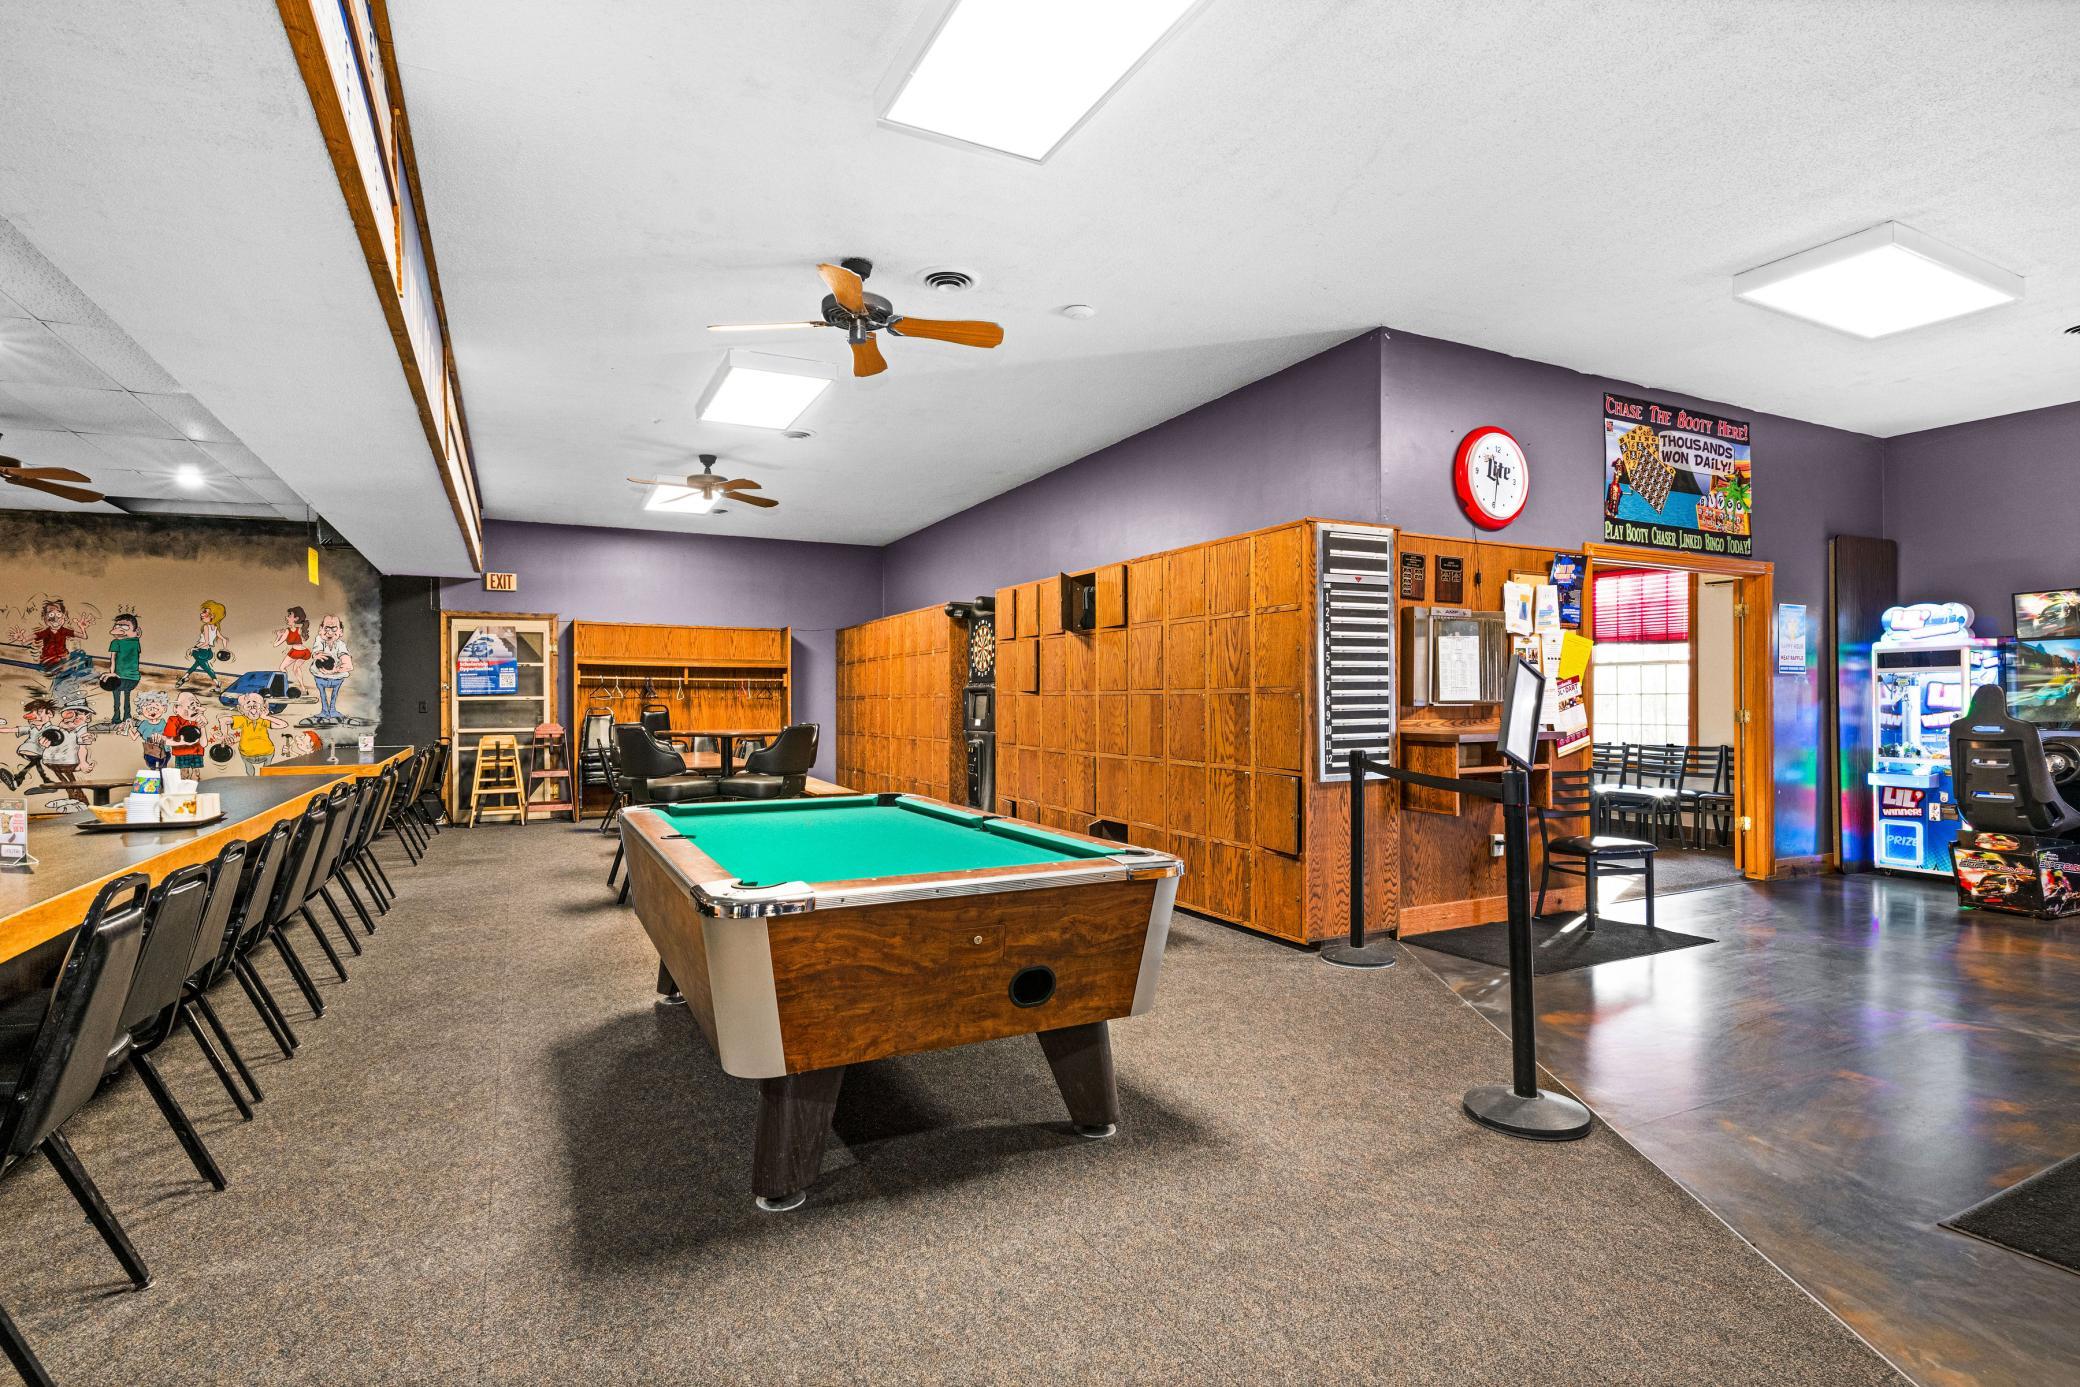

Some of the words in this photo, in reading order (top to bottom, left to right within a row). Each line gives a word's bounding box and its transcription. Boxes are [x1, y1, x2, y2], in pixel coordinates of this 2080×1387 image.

[1495, 445, 1502, 454] 12
[1660, 434, 1733, 459] THOUSANDS
[1662, 451, 1689, 465] WON
[1487, 458, 1511, 481] Lite
[490, 573, 513, 589] EXIT
[1325, 593, 1330, 602] 1
[1325, 607, 1330, 617] 2
[1325, 622, 1330, 632] 3
[1325, 637, 1330, 646] 4
[1325, 652, 1330, 661] 5
[1325, 667, 1330, 676] 6
[1325, 681, 1330, 691] 7
[1325, 696, 1330, 706] 8
[1325, 711, 1330, 720] 9
[1325, 726, 1332, 735] 10
[1325, 740, 1332, 750] 11
[1325, 755, 1332, 764] 12
[1886, 835, 1917, 847] PRIZE
